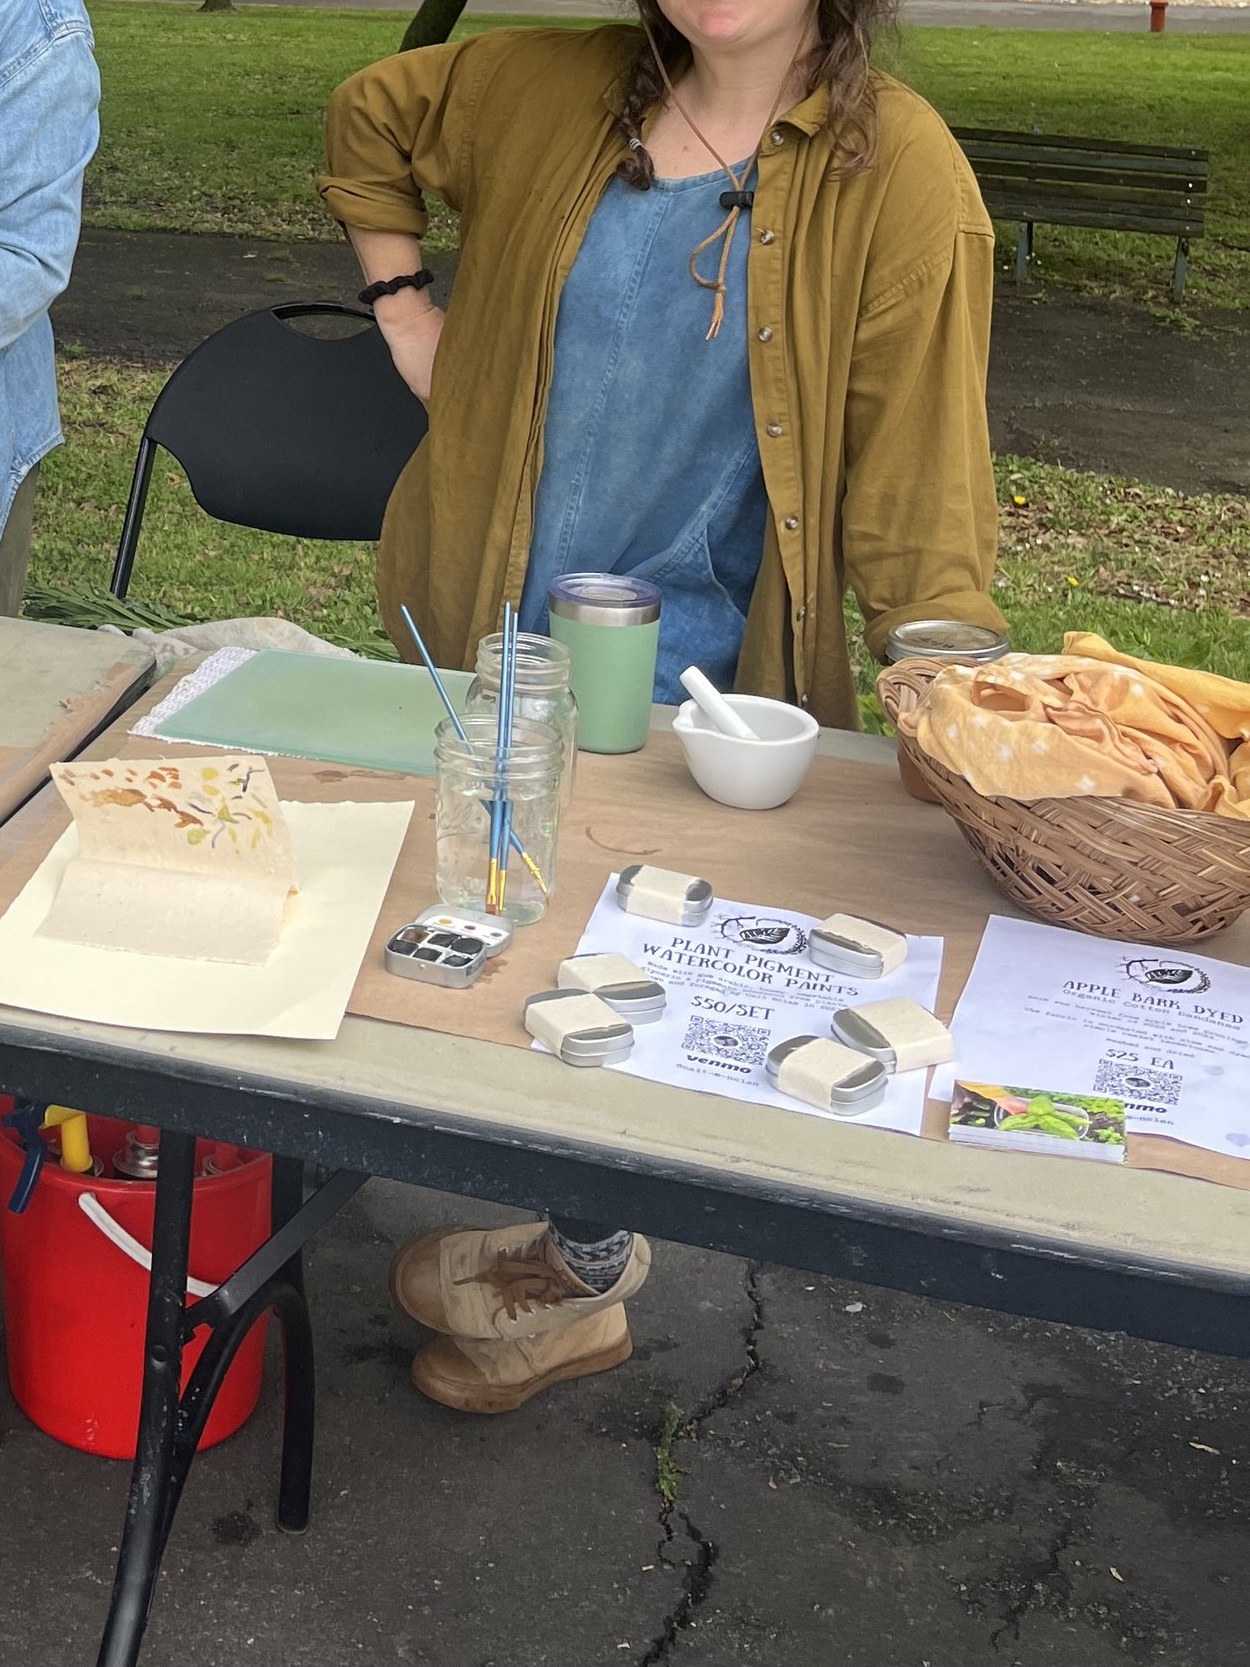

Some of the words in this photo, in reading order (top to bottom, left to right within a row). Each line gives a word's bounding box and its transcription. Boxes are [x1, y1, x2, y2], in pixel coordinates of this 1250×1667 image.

[642, 942, 774, 985] WATERCOLOR
[785, 977, 859, 997] PAINTS
[671, 936, 734, 959] PLANT
[744, 953, 835, 983] PIGMENT
[691, 995, 775, 1021] $50/SET
[1062, 989, 1116, 1004] Organic
[1123, 1001, 1170, 1014] Cotton
[1062, 980, 1121, 998] APPLE
[1131, 992, 1181, 1010] BARK
[1194, 1005, 1244, 1024] DYED
[686, 1054, 752, 1074] venmo
[1106, 1048, 1139, 1062] $25
[1150, 1057, 1174, 1070] EA
